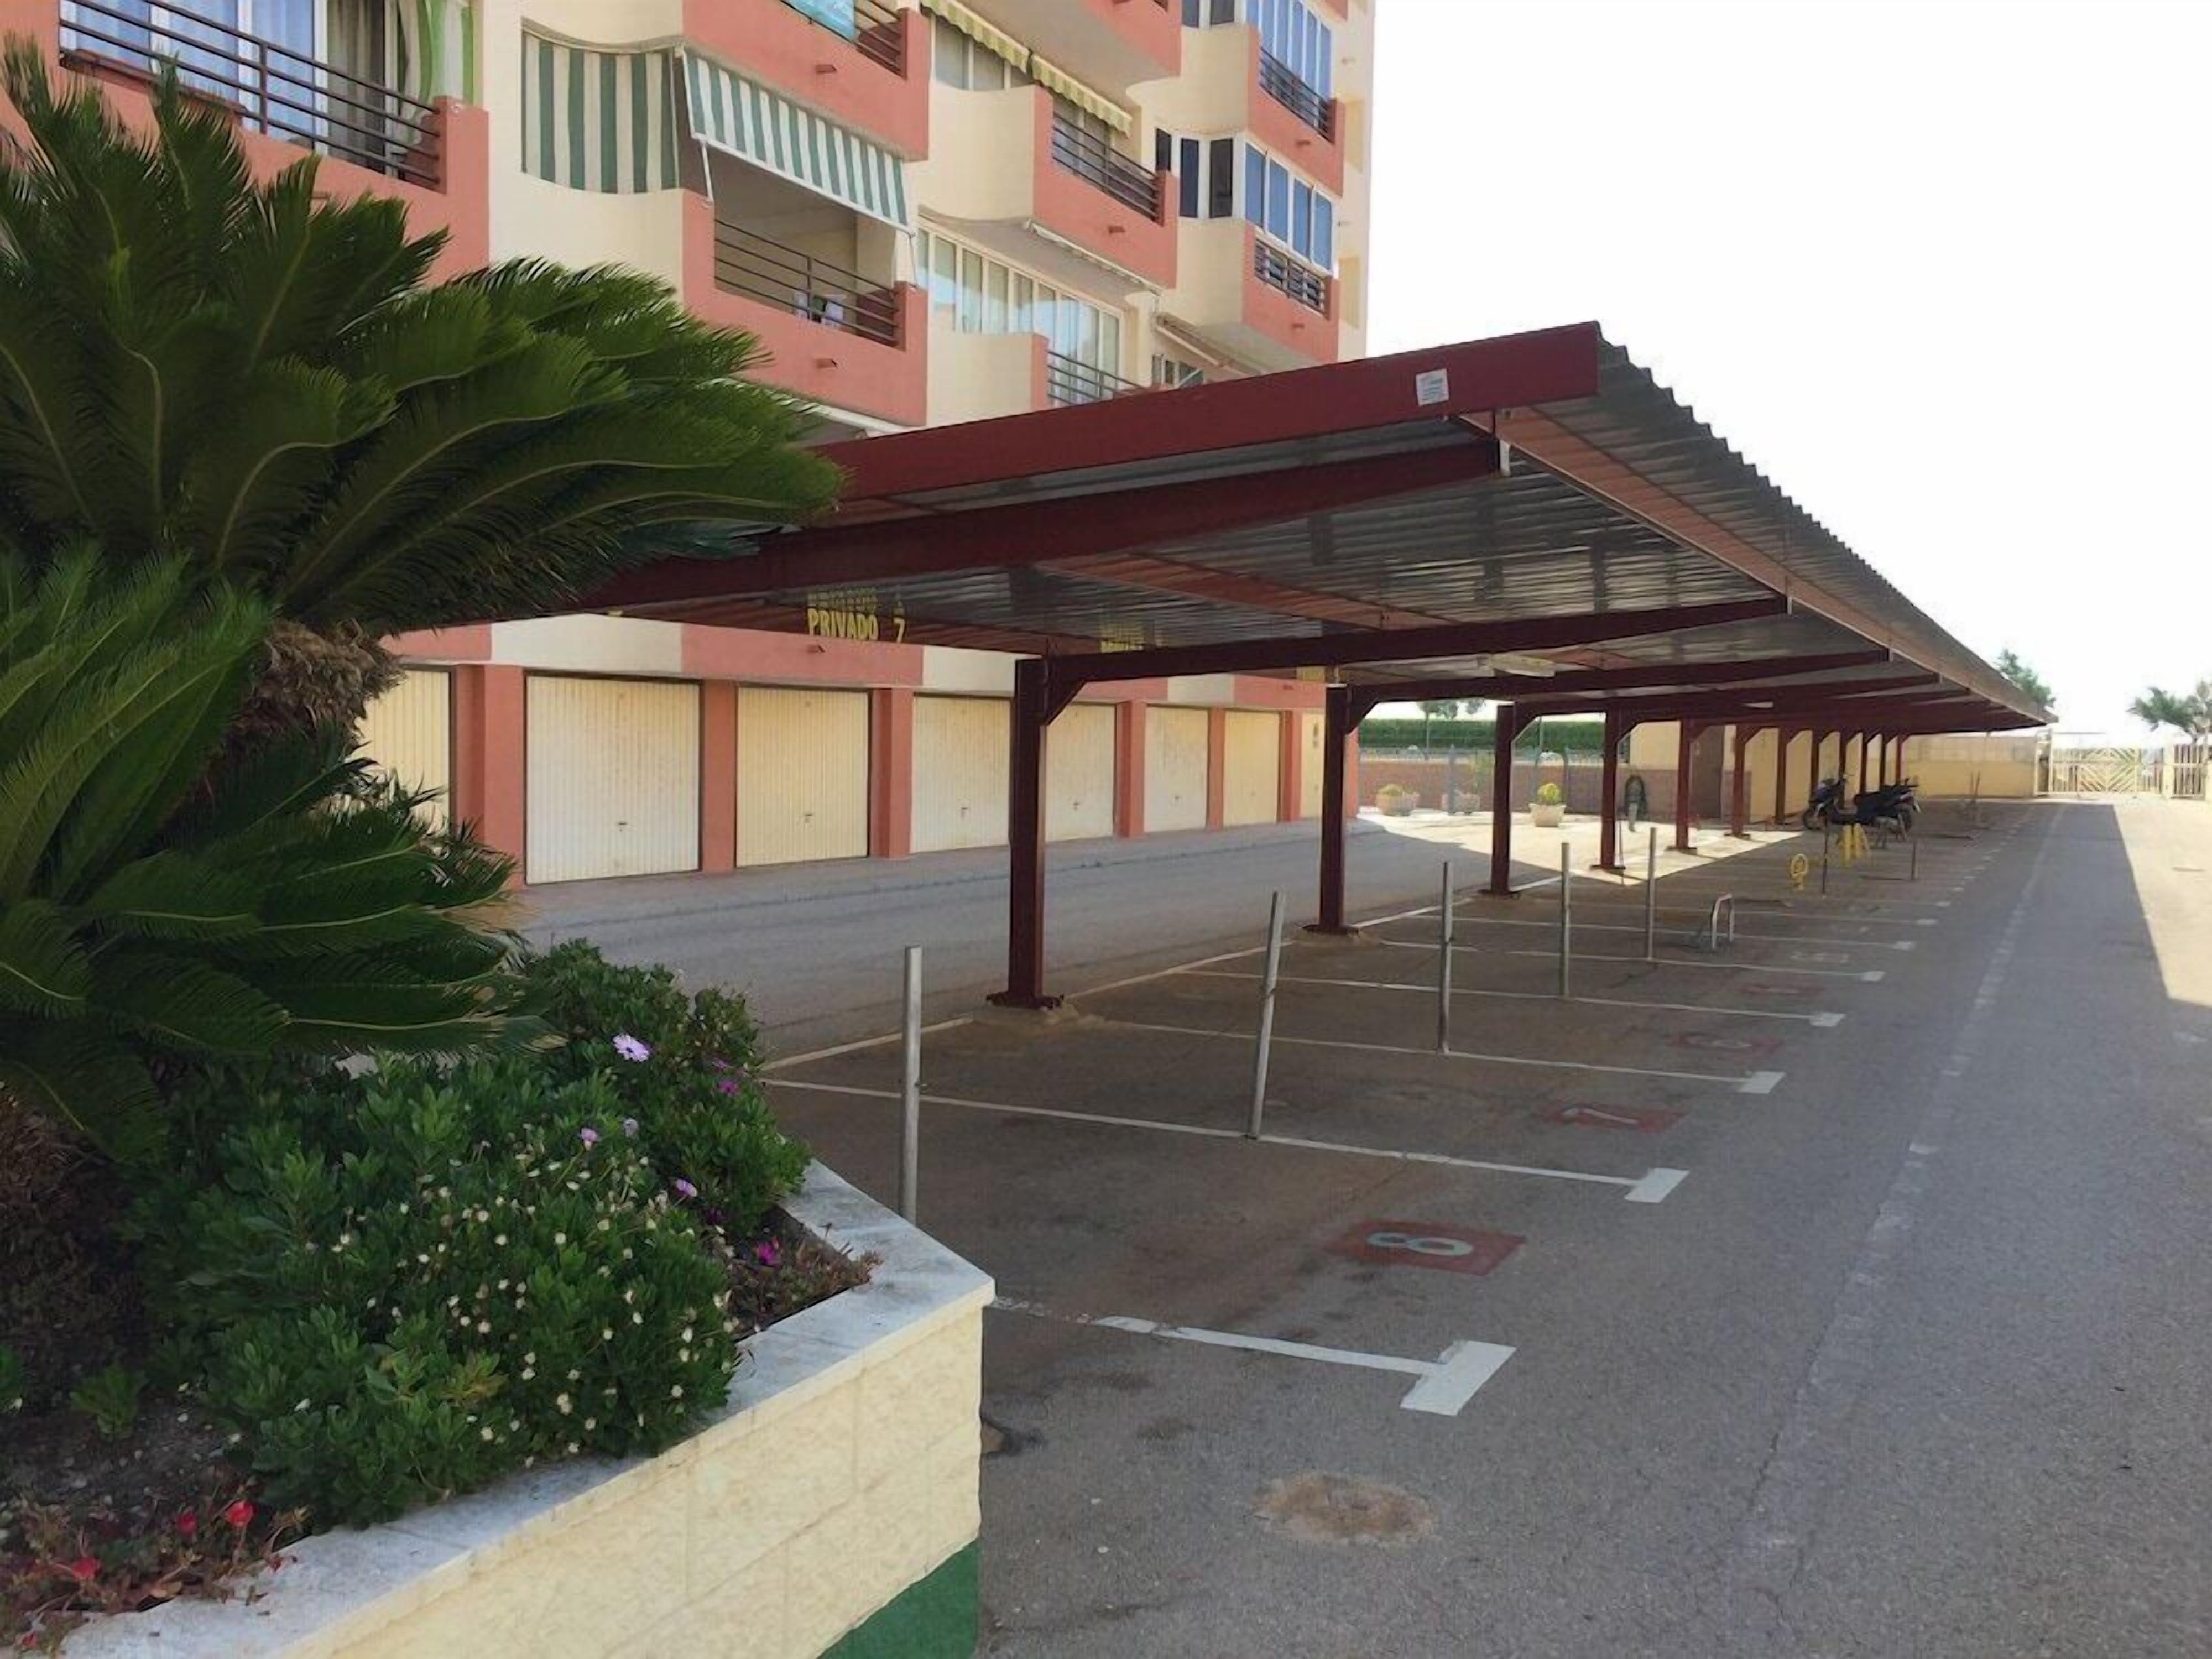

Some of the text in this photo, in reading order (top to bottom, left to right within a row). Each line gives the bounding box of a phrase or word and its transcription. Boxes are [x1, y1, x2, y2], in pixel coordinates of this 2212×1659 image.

[807, 608, 906, 644] PRIVADO 7
[1367, 1232, 1473, 1256] 8
